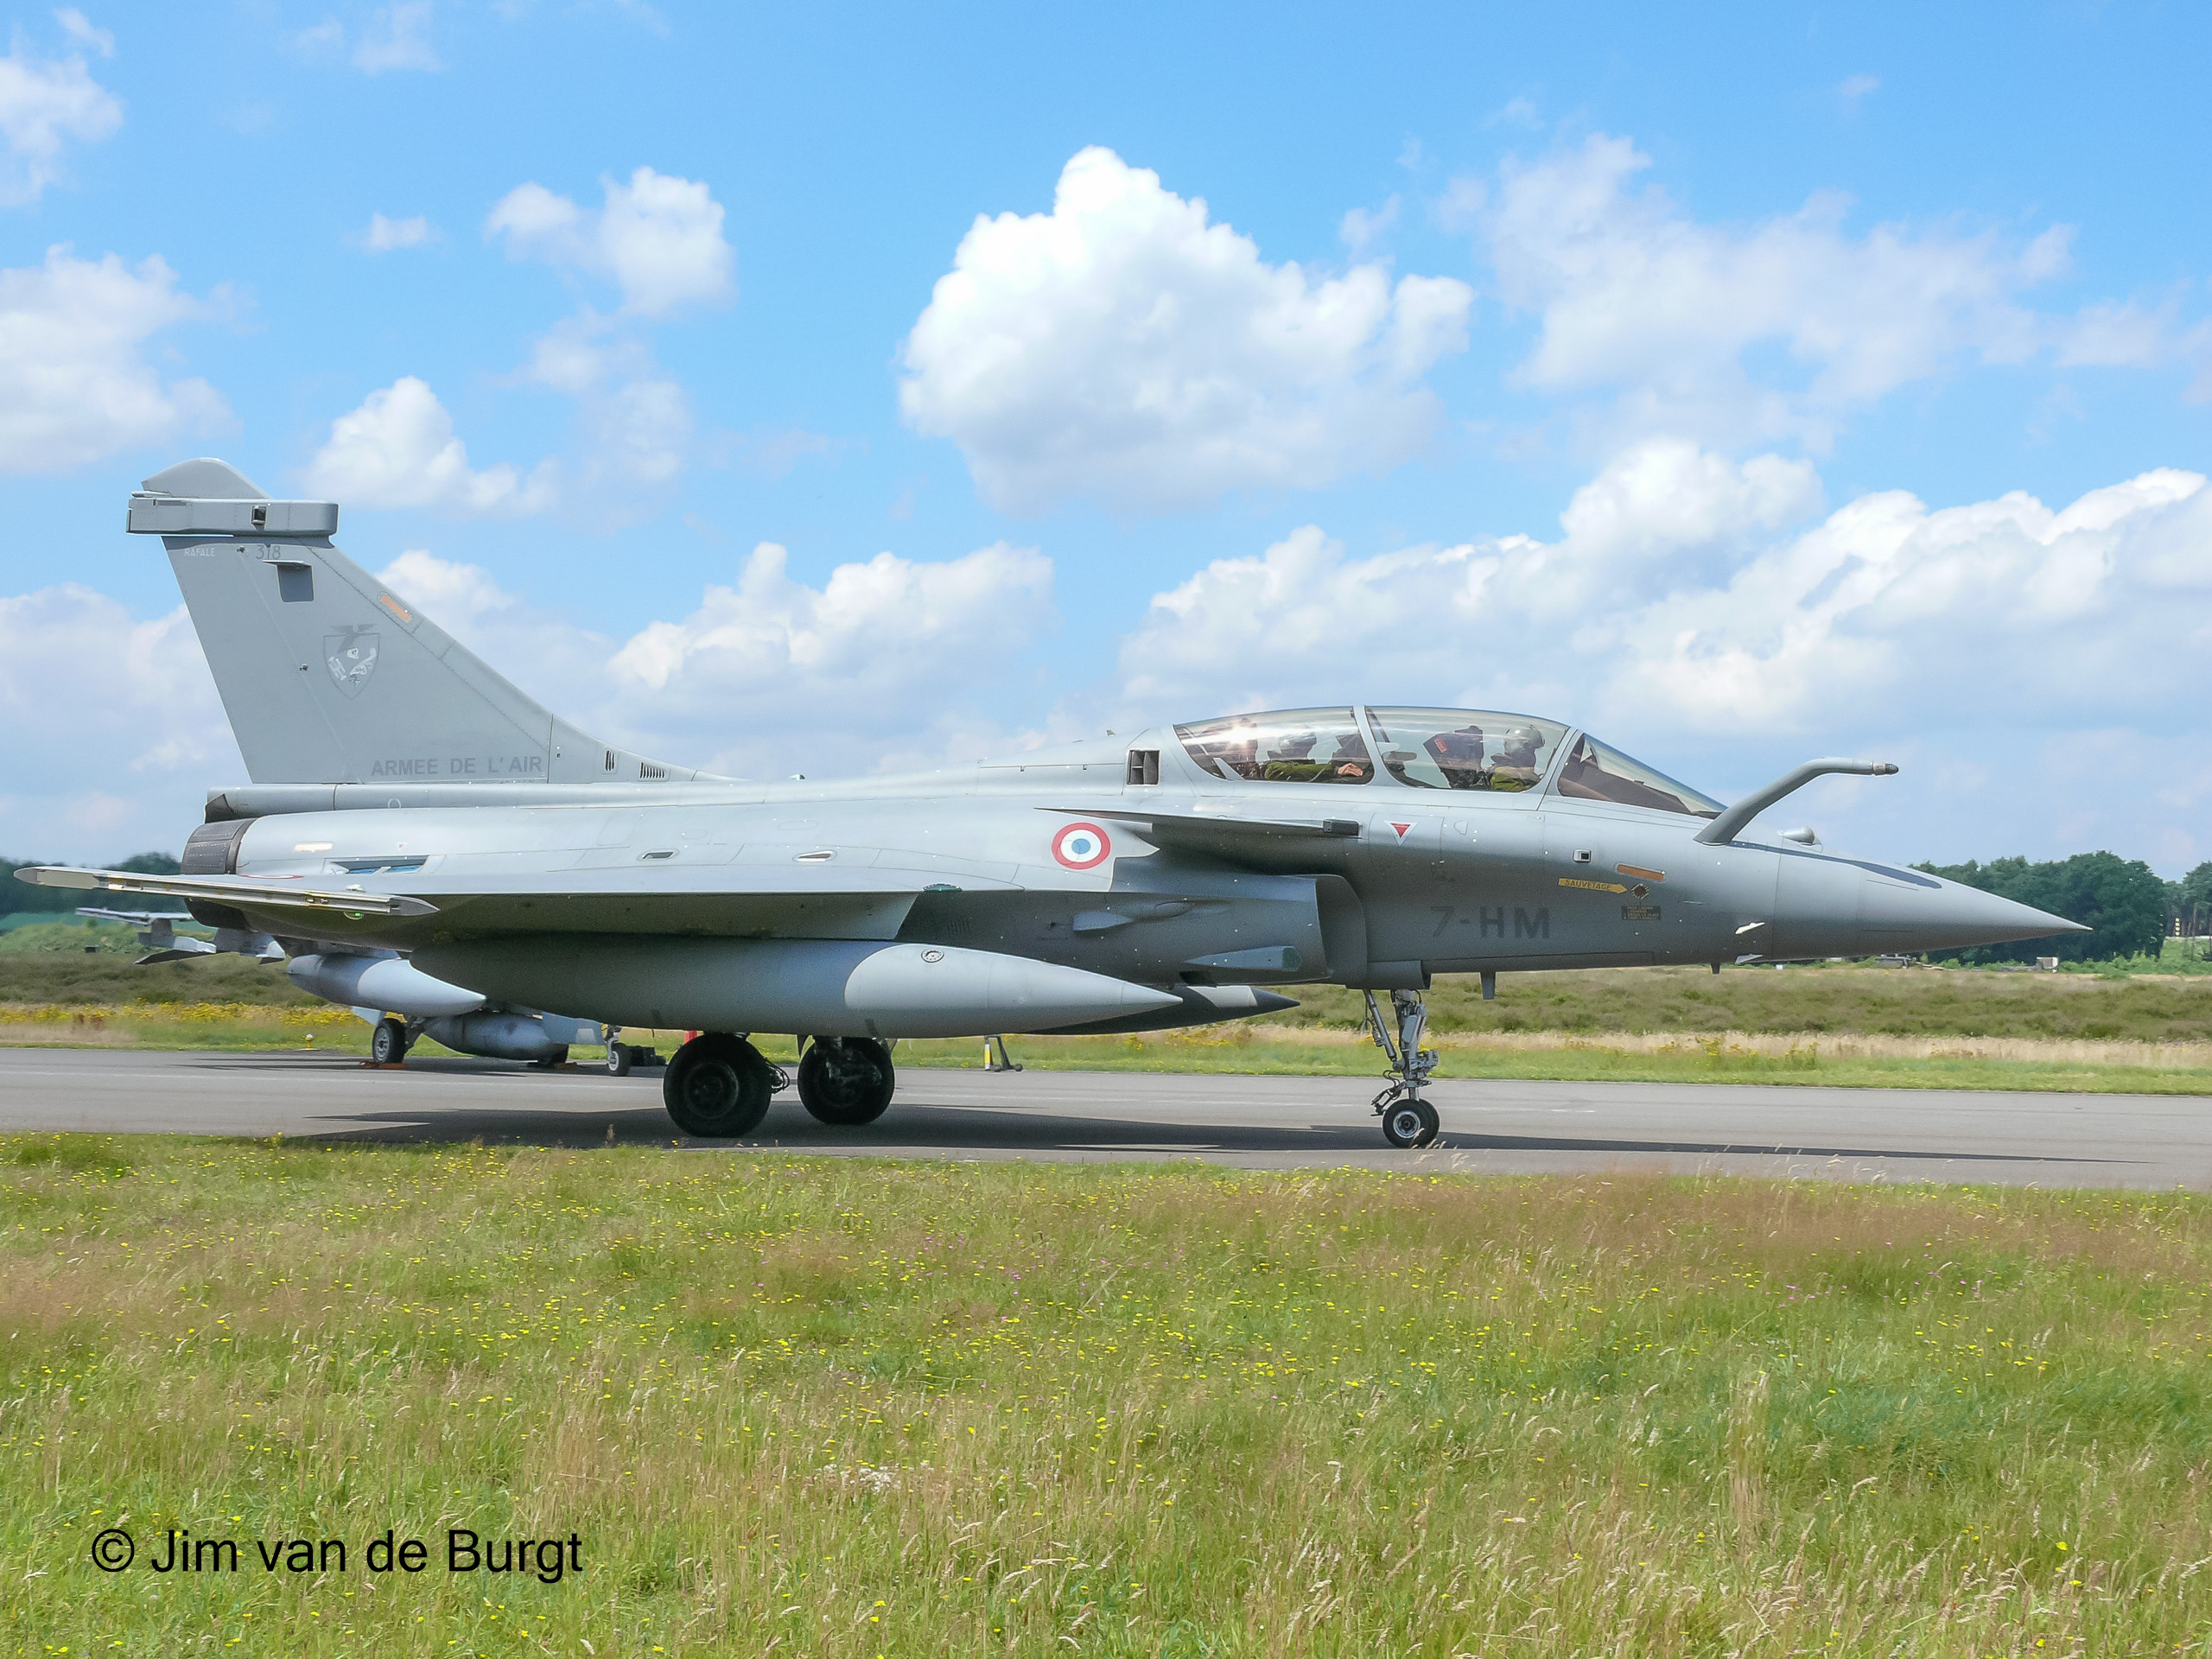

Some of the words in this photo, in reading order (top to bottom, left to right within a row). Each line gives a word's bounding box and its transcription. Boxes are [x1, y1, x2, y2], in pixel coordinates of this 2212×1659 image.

[184, 547, 215, 557] RAFALE
[256, 544, 282, 560] 318
[372, 759, 438, 776] ARMEE
[450, 758, 476, 774] DE
[1564, 879, 1611, 891] SAUVETAGE
[1430, 906, 1550, 939] 7-HM
